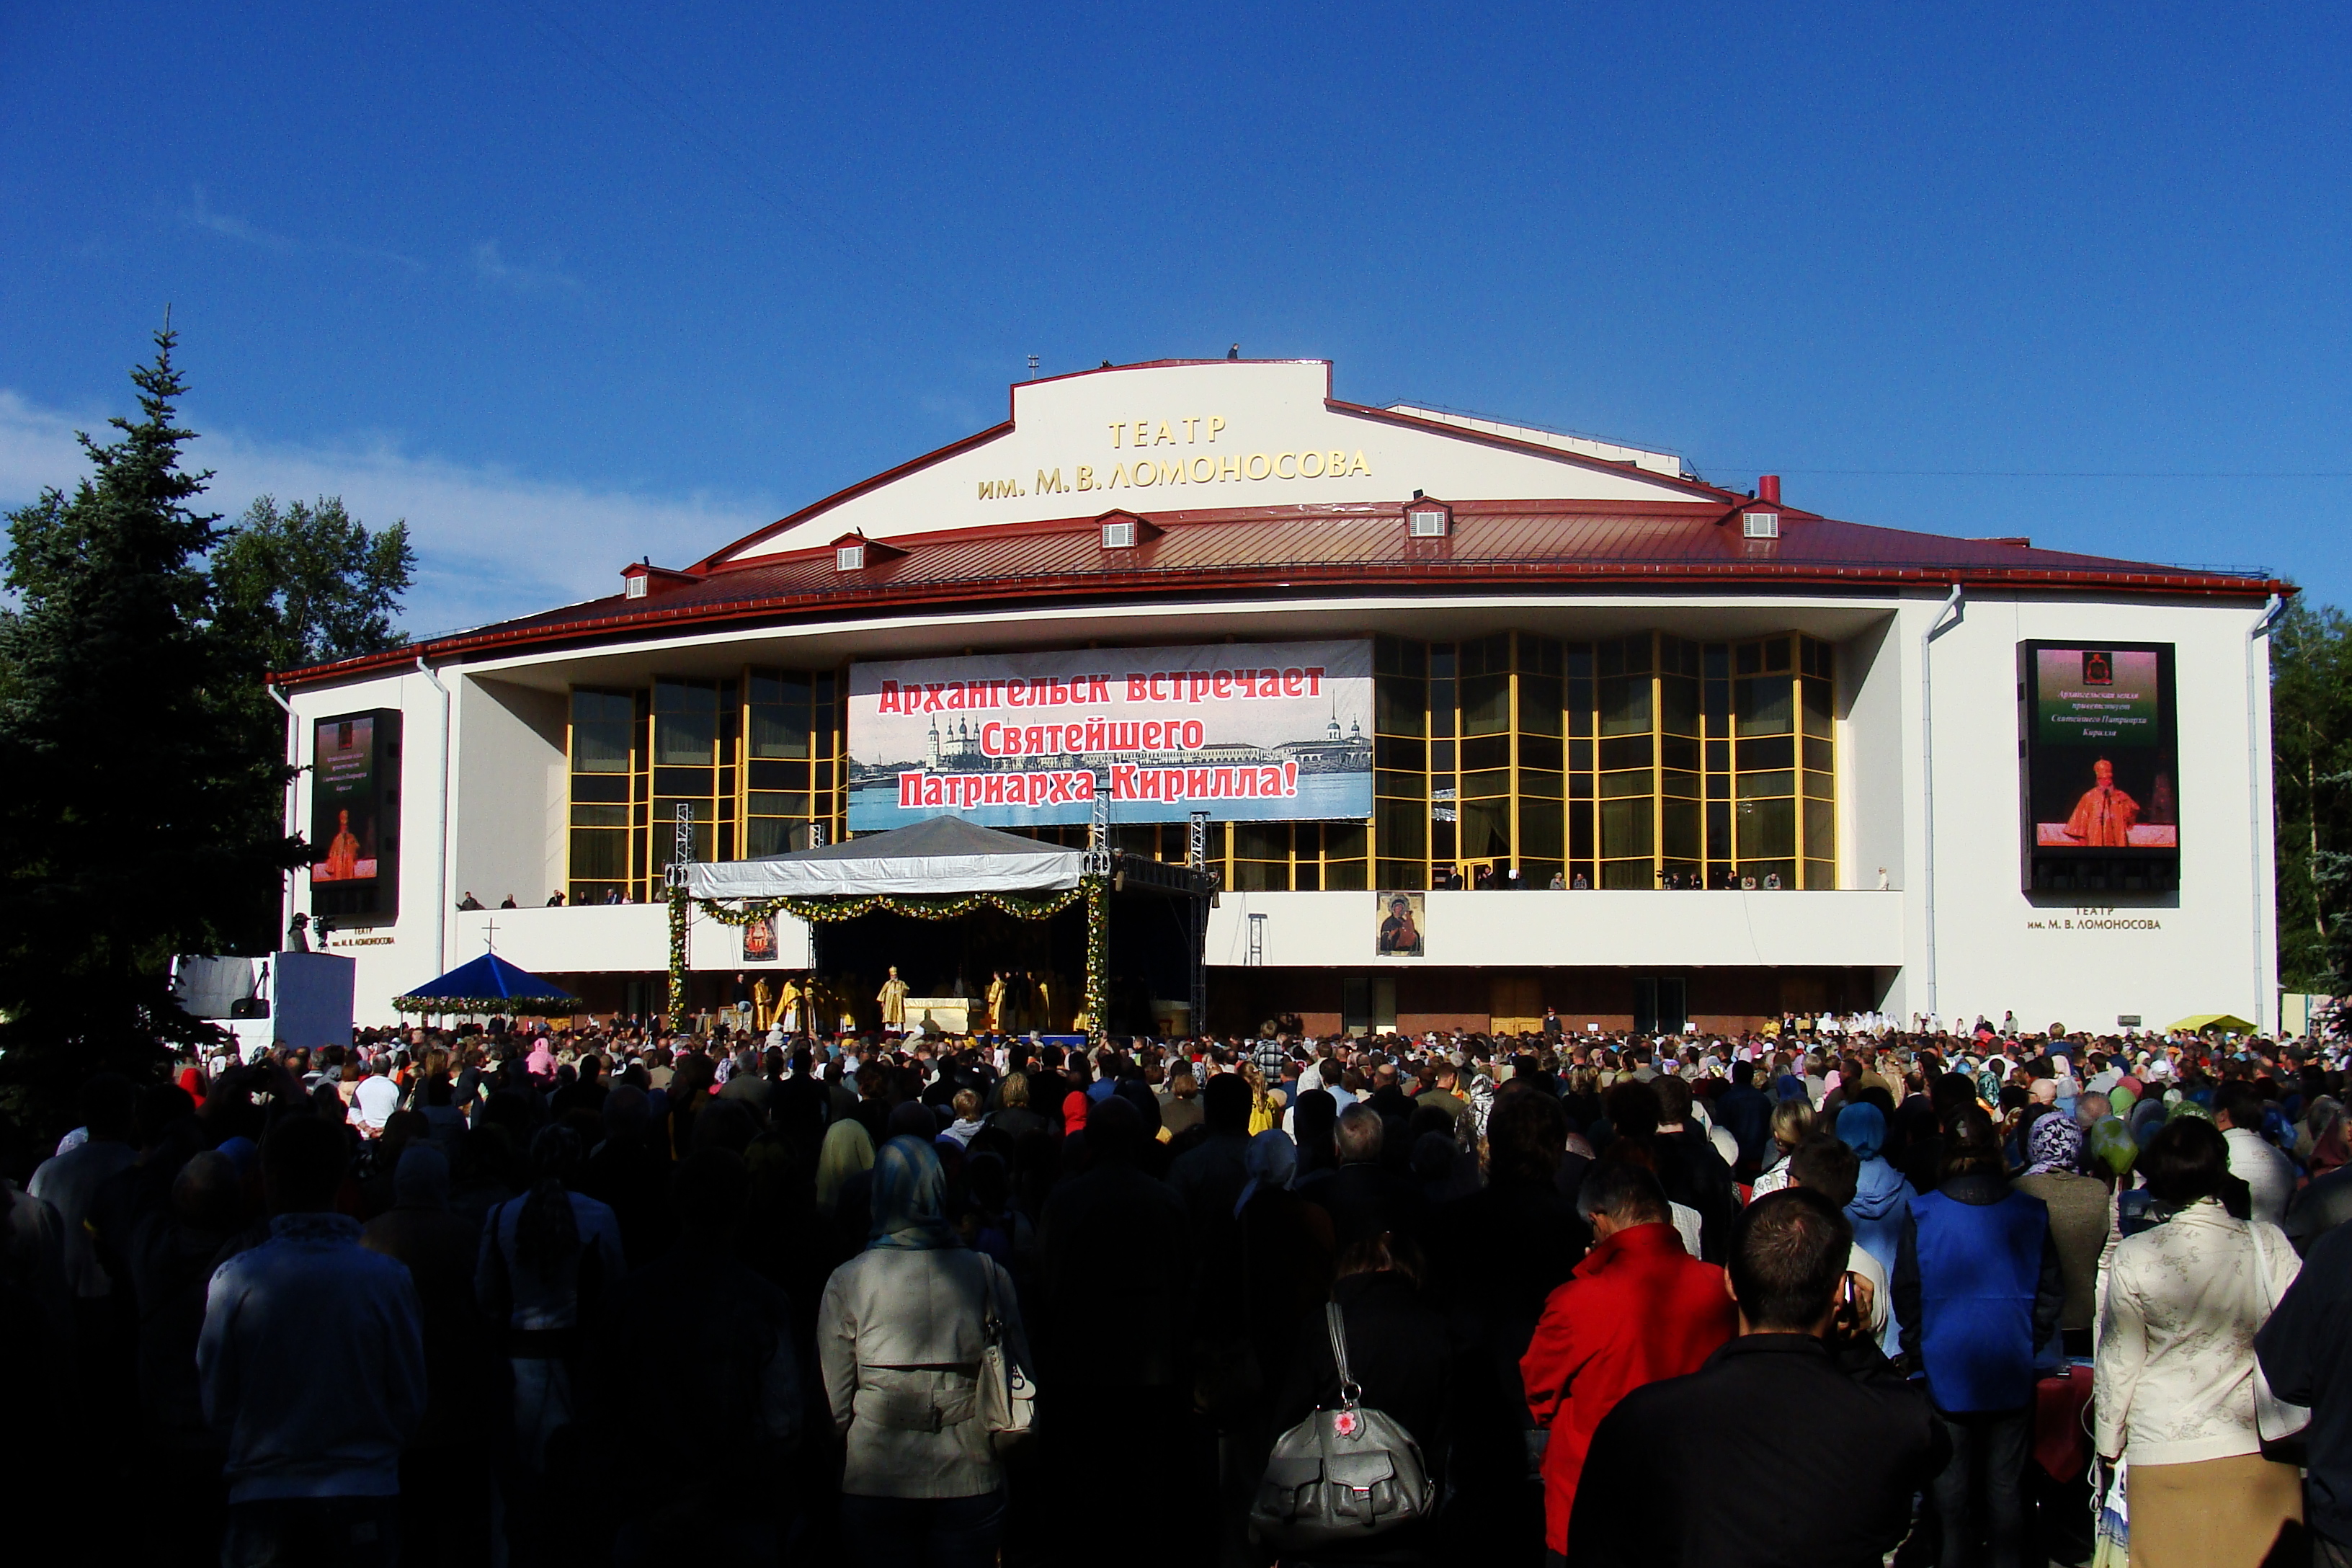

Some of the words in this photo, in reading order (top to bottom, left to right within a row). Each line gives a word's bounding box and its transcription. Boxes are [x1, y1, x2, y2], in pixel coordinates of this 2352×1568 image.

[1109, 415, 1226, 448] ТЕАТР
[1108, 450, 1371, 489] ЛОМОНОСОВА
[878, 673, 1111, 716] Архангельск
[1126, 667, 1325, 703] встречает
[981, 717, 1203, 755] Святейшего
[900, 772, 1095, 808] Патриарха
[1110, 762, 1297, 802] Кирилла!
[2076, 906, 2114, 916] ТЕАТР
[2077, 919, 2161, 930] ЛОМОНОСОВА
